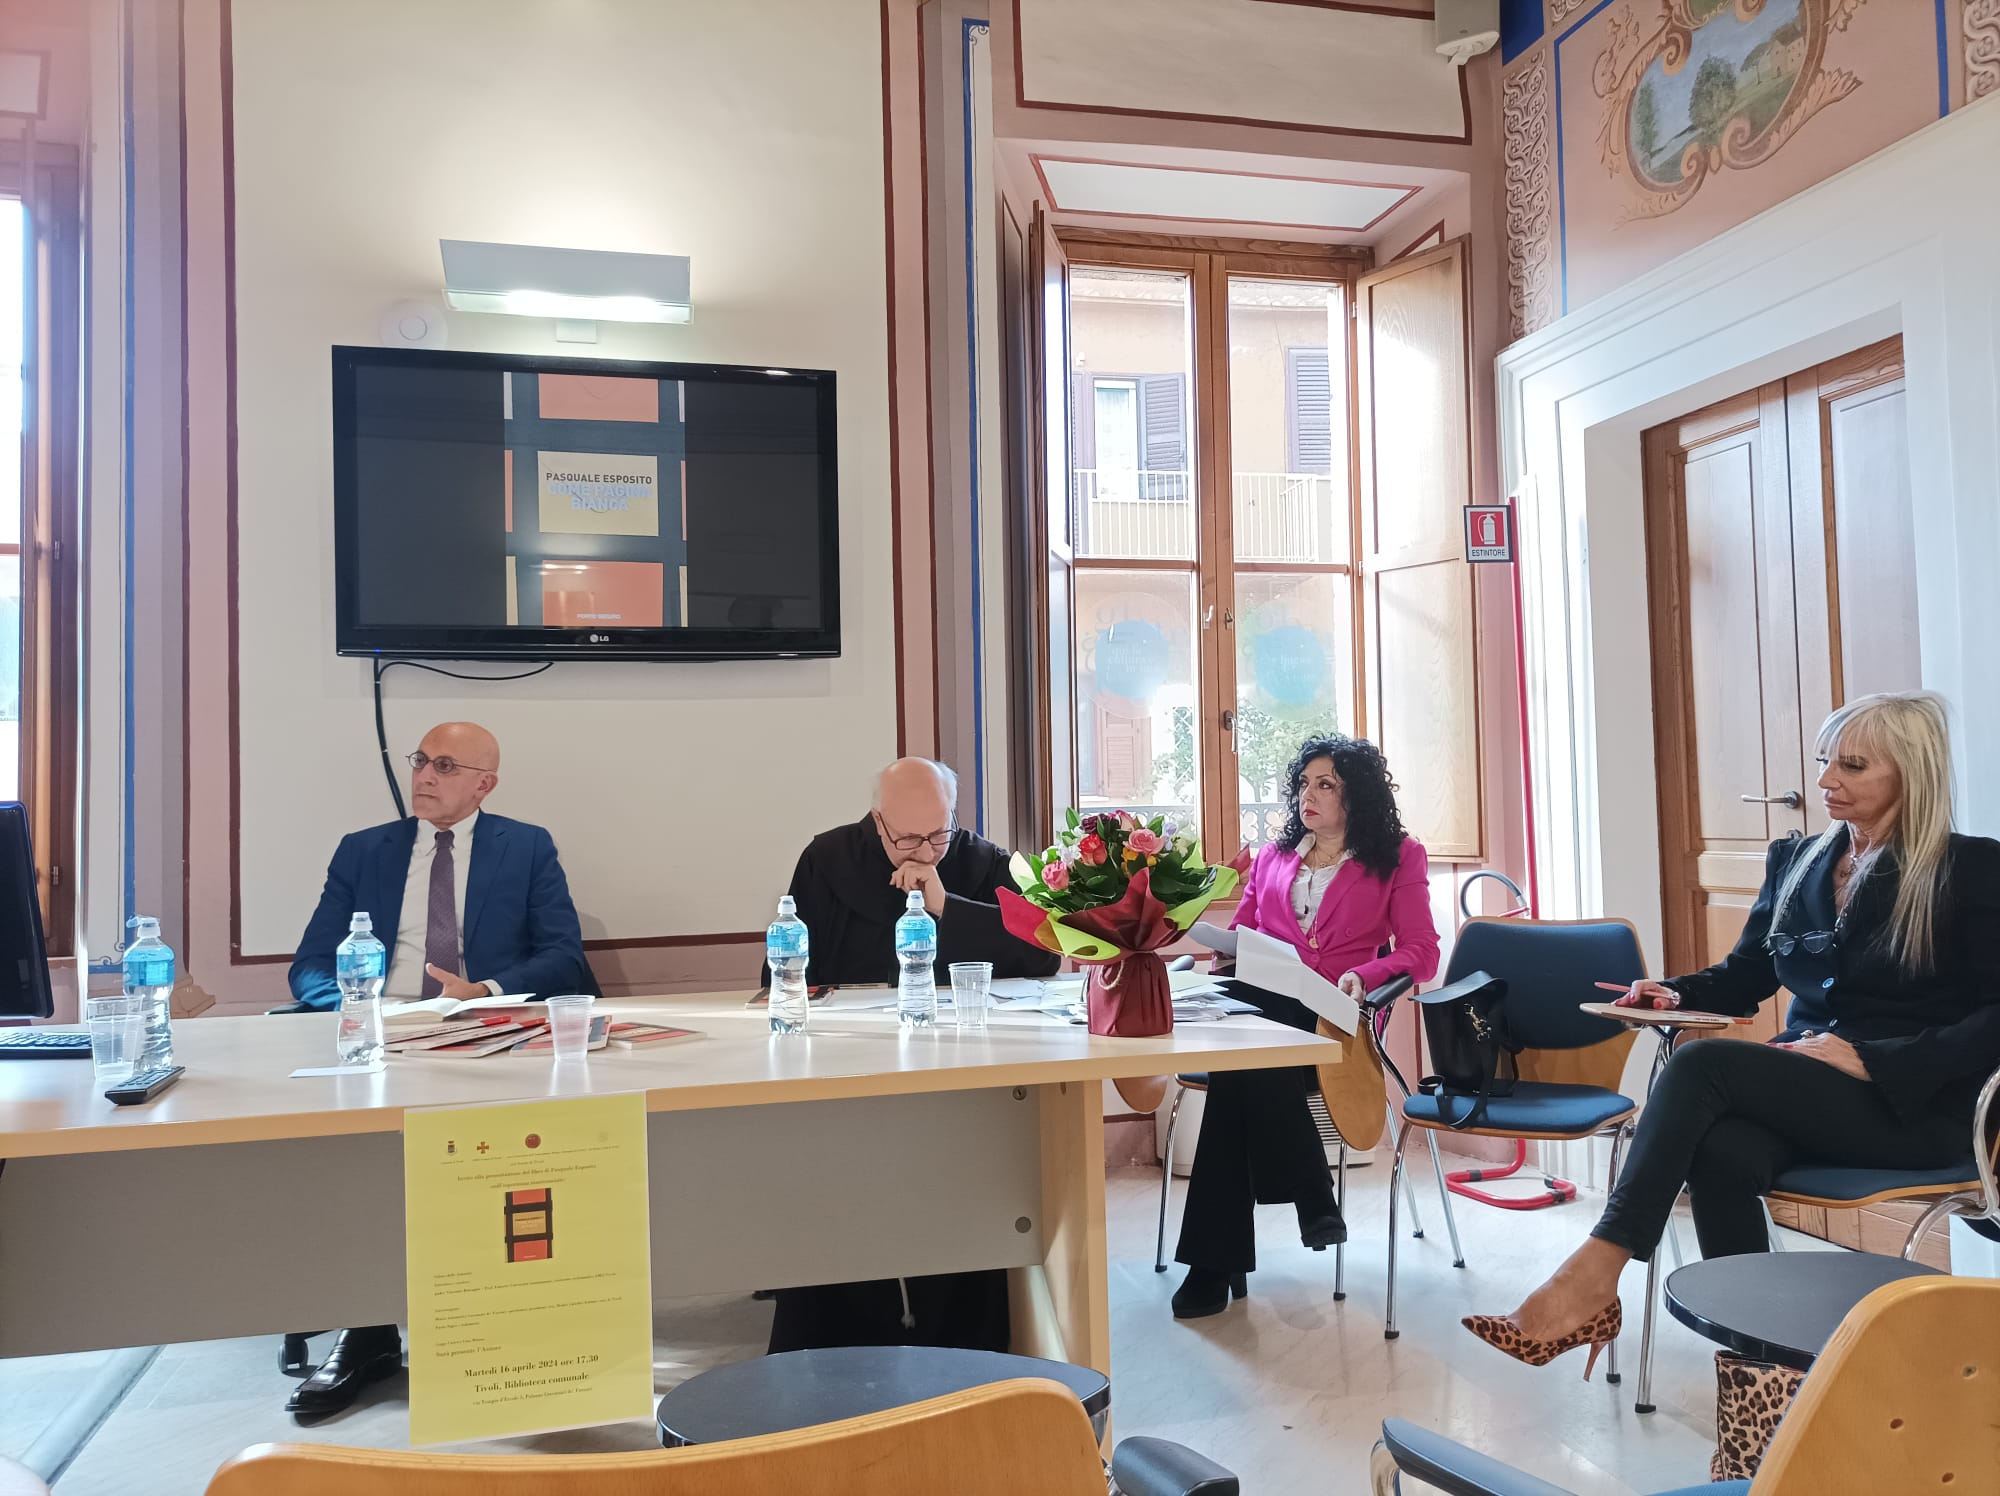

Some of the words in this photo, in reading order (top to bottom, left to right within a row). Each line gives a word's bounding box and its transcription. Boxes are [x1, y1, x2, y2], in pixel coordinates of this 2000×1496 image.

[546, 472, 601, 483] PASQUALE
[603, 474, 652, 485] ESPOSITO
[1471, 548, 1506, 557] ESTINTORE
[500, 1364, 510, 1374] 16
[511, 1361, 536, 1374] aprile
[538, 1359, 558, 1369] 2024
[560, 1359, 574, 1367] ore
[576, 1354, 599, 1365] 17.30
[504, 1378, 546, 1390] Biblioteca
[548, 1372, 590, 1384] comunale
